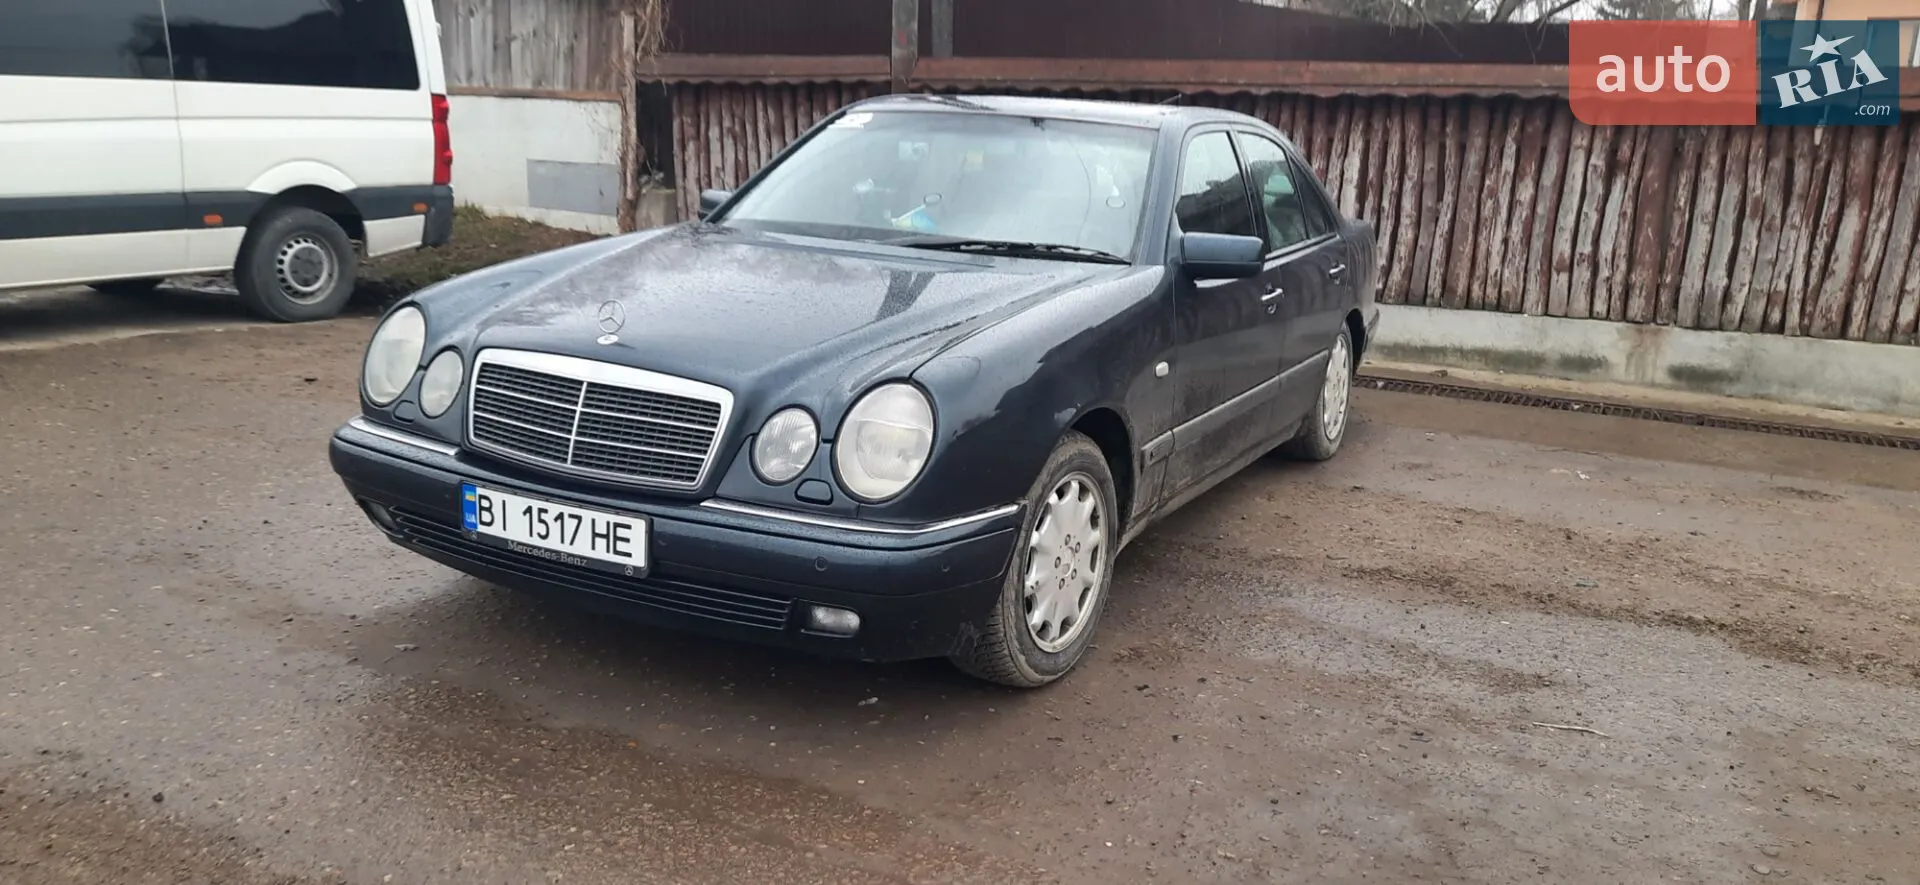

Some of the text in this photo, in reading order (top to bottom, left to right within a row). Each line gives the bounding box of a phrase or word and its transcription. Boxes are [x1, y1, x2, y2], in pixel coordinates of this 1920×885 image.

[465, 512, 476, 524] UA
[478, 494, 632, 558] BI 1517 HE
[507, 540, 587, 566] Mercedes-Benz
